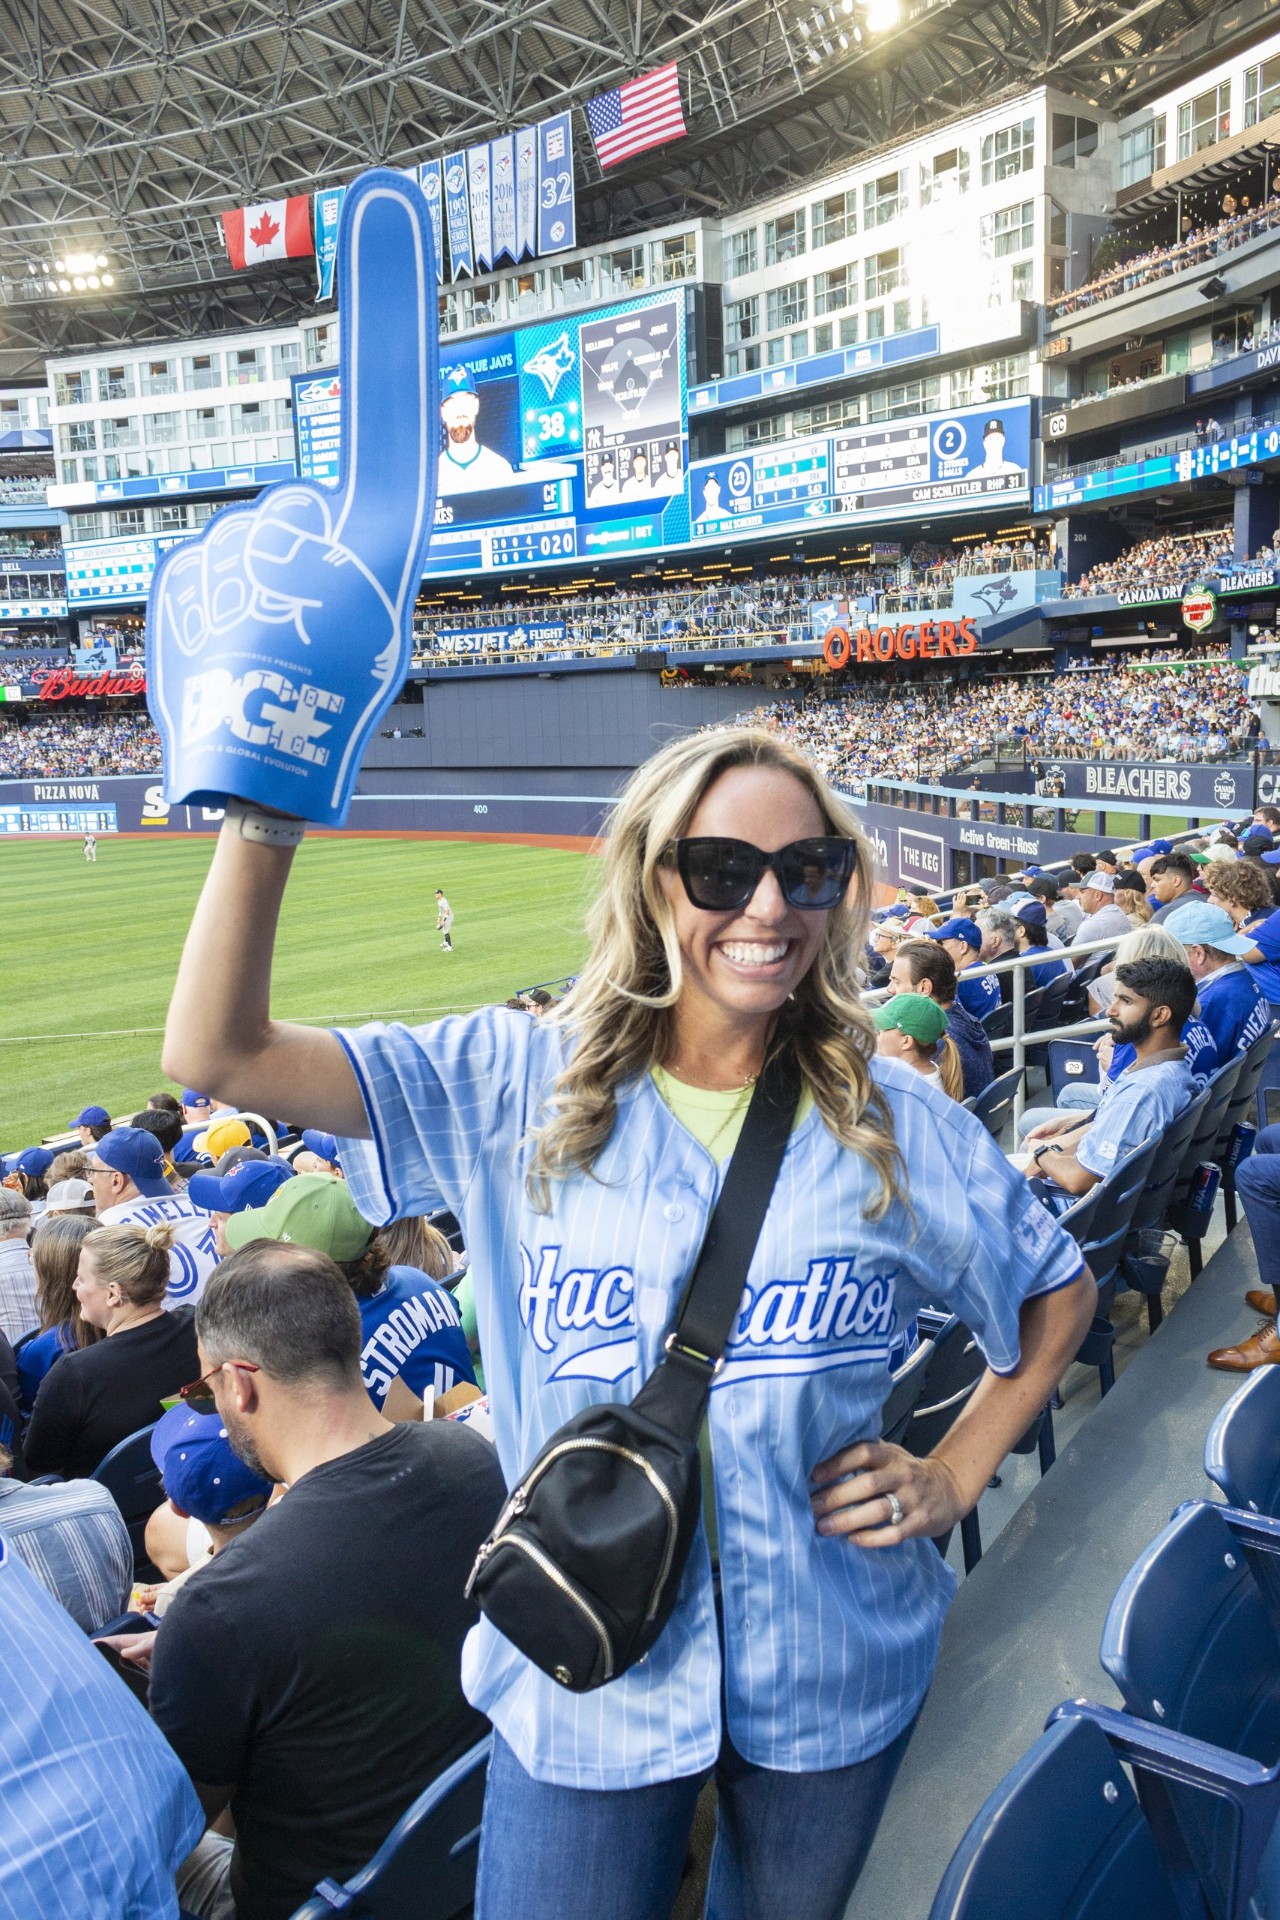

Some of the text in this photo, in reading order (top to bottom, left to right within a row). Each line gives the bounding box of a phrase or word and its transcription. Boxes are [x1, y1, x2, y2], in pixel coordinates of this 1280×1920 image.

[494, 184, 513, 200] 2016
[541, 172, 572, 209] 32
[449, 196, 466, 216] 1993
[471, 190, 489, 209] 2015
[429, 204, 440, 221] 92
[450, 216, 468, 228] WORLD
[450, 229, 468, 241] SERIES
[451, 243, 469, 255] CHAMPS
[489, 353, 514, 370] JAYS
[1257, 347, 1280, 368] DAVI
[538, 411, 565, 441] 38
[1052, 419, 1065, 433] CC
[945, 432, 955, 448] 2
[1197, 448, 1204, 462] 3
[1212, 444, 1219, 459] 0
[1231, 438, 1238, 453] 0
[1251, 432, 1257, 447] 4
[1269, 431, 1278, 453] 0
[619, 448, 631, 461] 90
[651, 442, 660, 456] 11
[860, 464, 866, 473] K
[1197, 462, 1204, 477] 0
[1212, 458, 1219, 473] 0
[1231, 454, 1238, 468] 0
[1250, 447, 1257, 462] 4
[733, 471, 747, 487] 23
[1087, 475, 1093, 488] 3
[543, 484, 557, 503] CF
[913, 475, 1019, 501] CAM SCHLITTLER RHP 31
[434, 508, 453, 525] KES
[635, 525, 653, 538] BET
[1074, 533, 1087, 542] 204
[493, 535, 532, 550] 3 0 0 4
[493, 550, 534, 564] 0 0 0 4
[2, 562, 21, 571] BELL
[1118, 571, 1274, 605] CANADA DRY BLEACHERS
[1182, 602, 1212, 613] CANADA
[1189, 612, 1205, 621] DRY
[438, 627, 564, 652] WESTJET FLIGHT
[857, 617, 979, 663] ROGERS
[274, 658, 313, 676] PRESENTS
[226, 745, 261, 762] GLOBAL
[264, 756, 308, 777] EVOLUTON
[1086, 766, 1191, 800] BLEACHERS
[1214, 784, 1236, 793] CANADA
[34, 784, 99, 800] PIZZA NOVA
[1219, 792, 1231, 801] DRY
[473, 804, 488, 814] 400
[960, 828, 985, 846] Active
[903, 846, 920, 868] THE
[922, 852, 939, 873] KEG
[1068, 1063, 1080, 1072] 29
[1232, 1138, 1243, 1161] LIGHT
[1192, 1189, 1206, 1210] TRA
[360, 1289, 461, 1396] STROMAN
